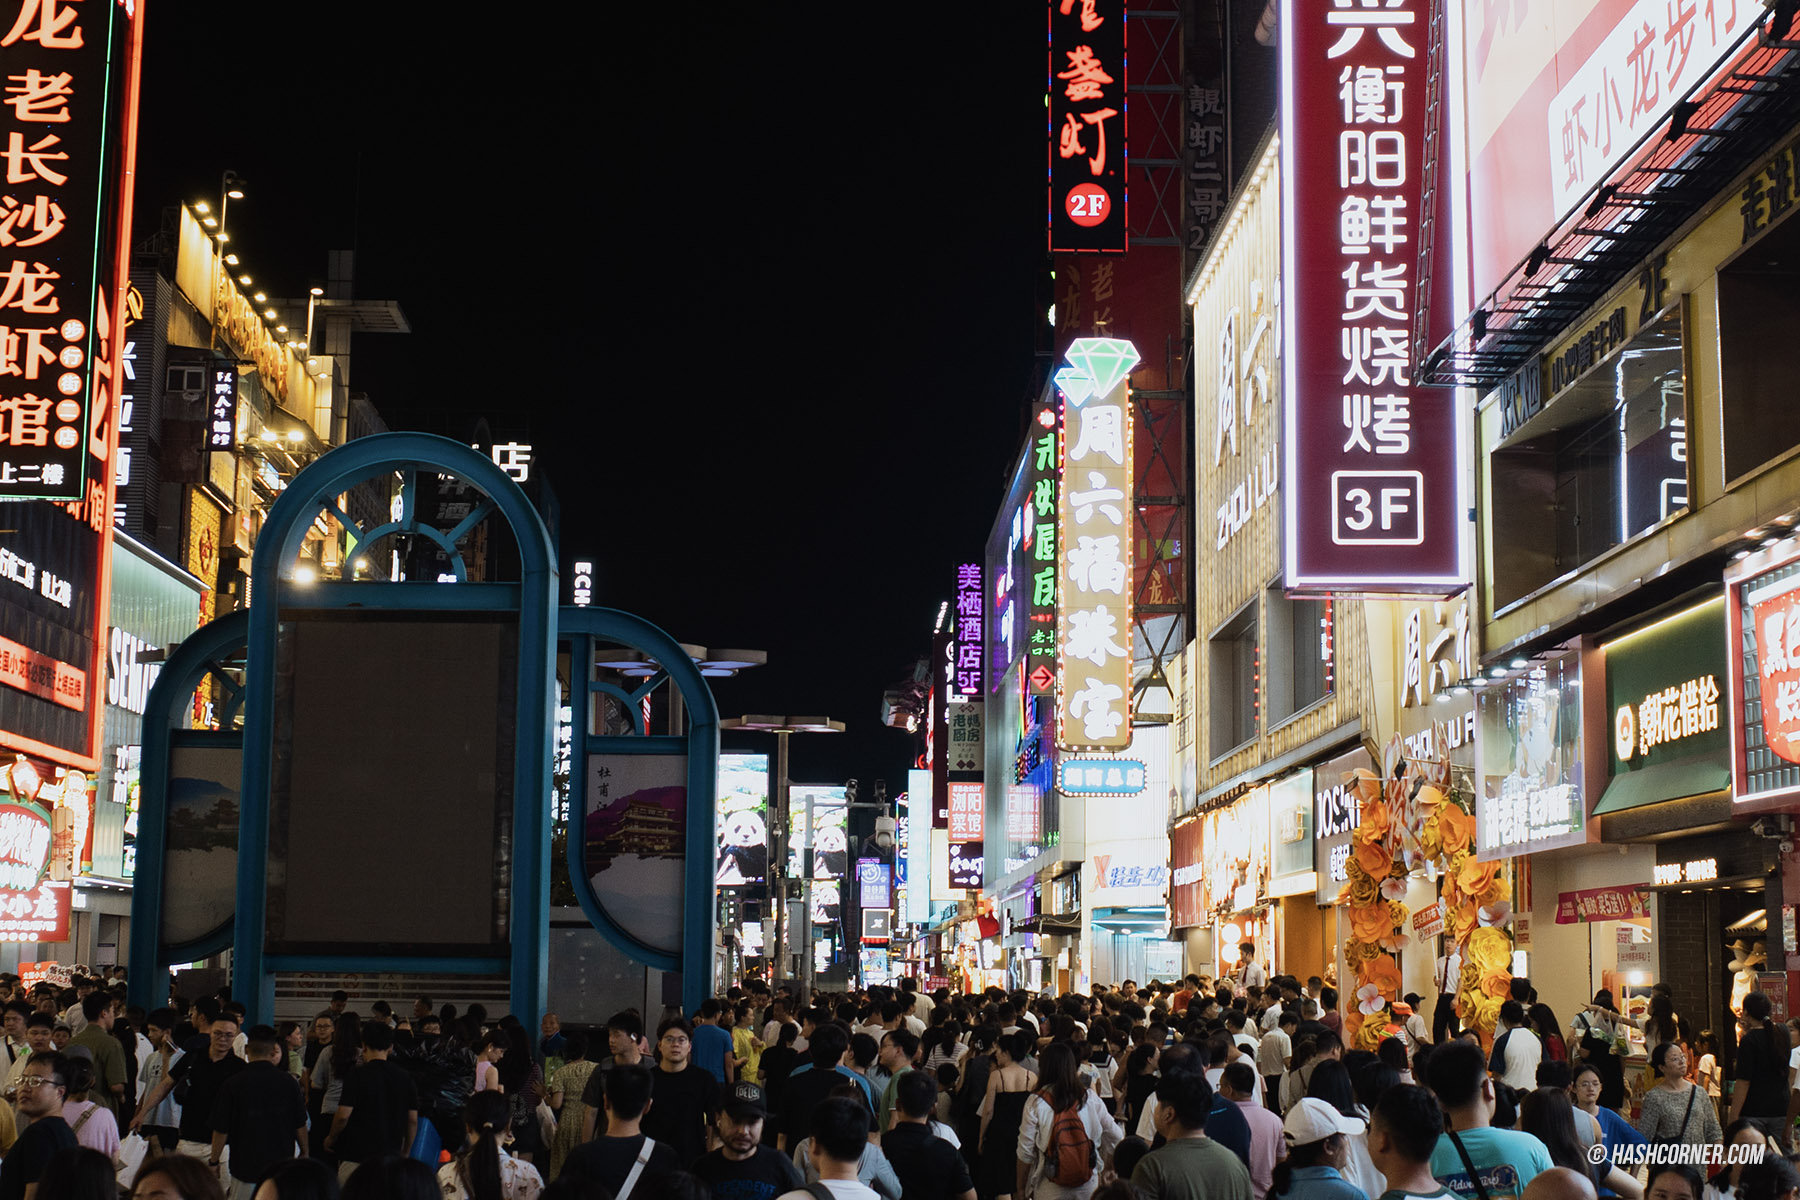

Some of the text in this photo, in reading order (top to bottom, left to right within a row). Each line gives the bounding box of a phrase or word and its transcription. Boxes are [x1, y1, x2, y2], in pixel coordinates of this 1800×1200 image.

[1071, 195, 1105, 216] 2F
[1339, 65, 1411, 455] 衡阳鲜货烧烤
[1345, 488, 1411, 530] 3F
[574, 562, 592, 607] ECH
[957, 563, 982, 669] 美栖酒店
[957, 671, 981, 688] 5F
[952, 792, 982, 812] 浏阳
[952, 813, 982, 832] 菜馆
